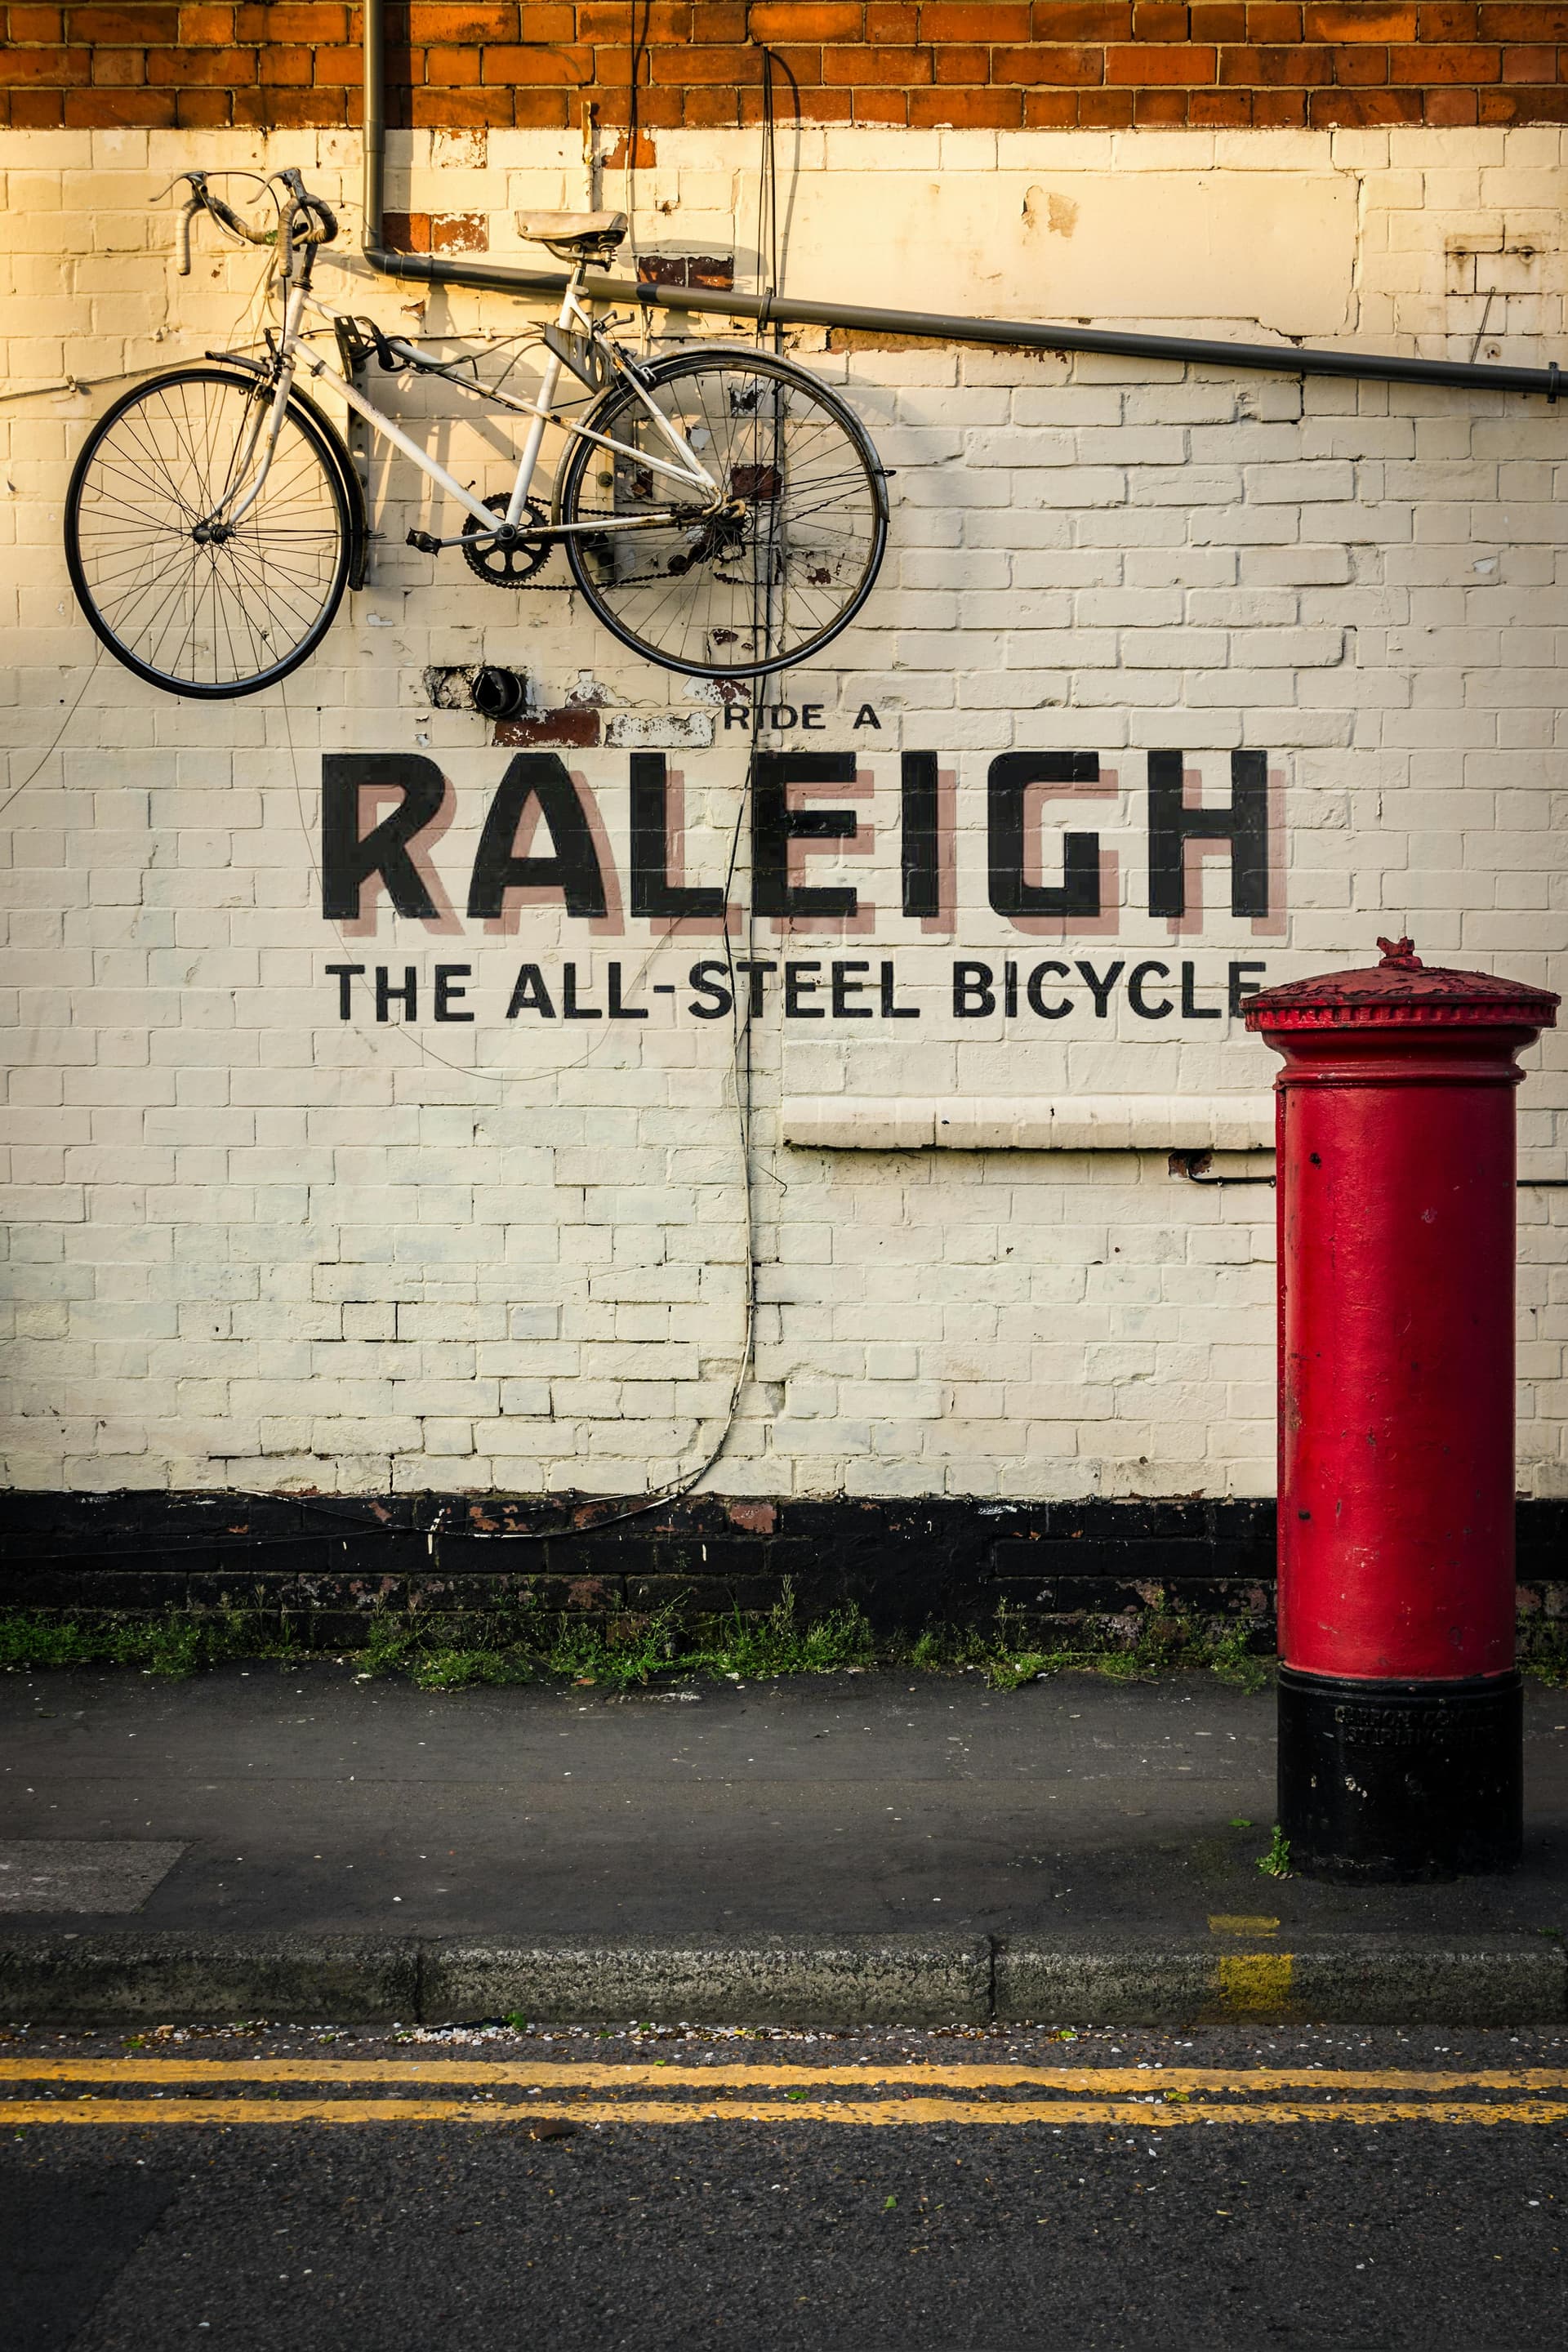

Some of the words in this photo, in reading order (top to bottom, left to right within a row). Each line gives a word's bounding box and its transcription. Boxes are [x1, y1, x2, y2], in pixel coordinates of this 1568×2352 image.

[724, 704, 826, 730] RIDE
[853, 703, 882, 729] A
[321, 750, 1286, 937] RALEIGH
[325, 964, 474, 1022] THE
[505, 960, 920, 1020] ALL-STEEL
[952, 960, 1267, 1020] BICYCLE
